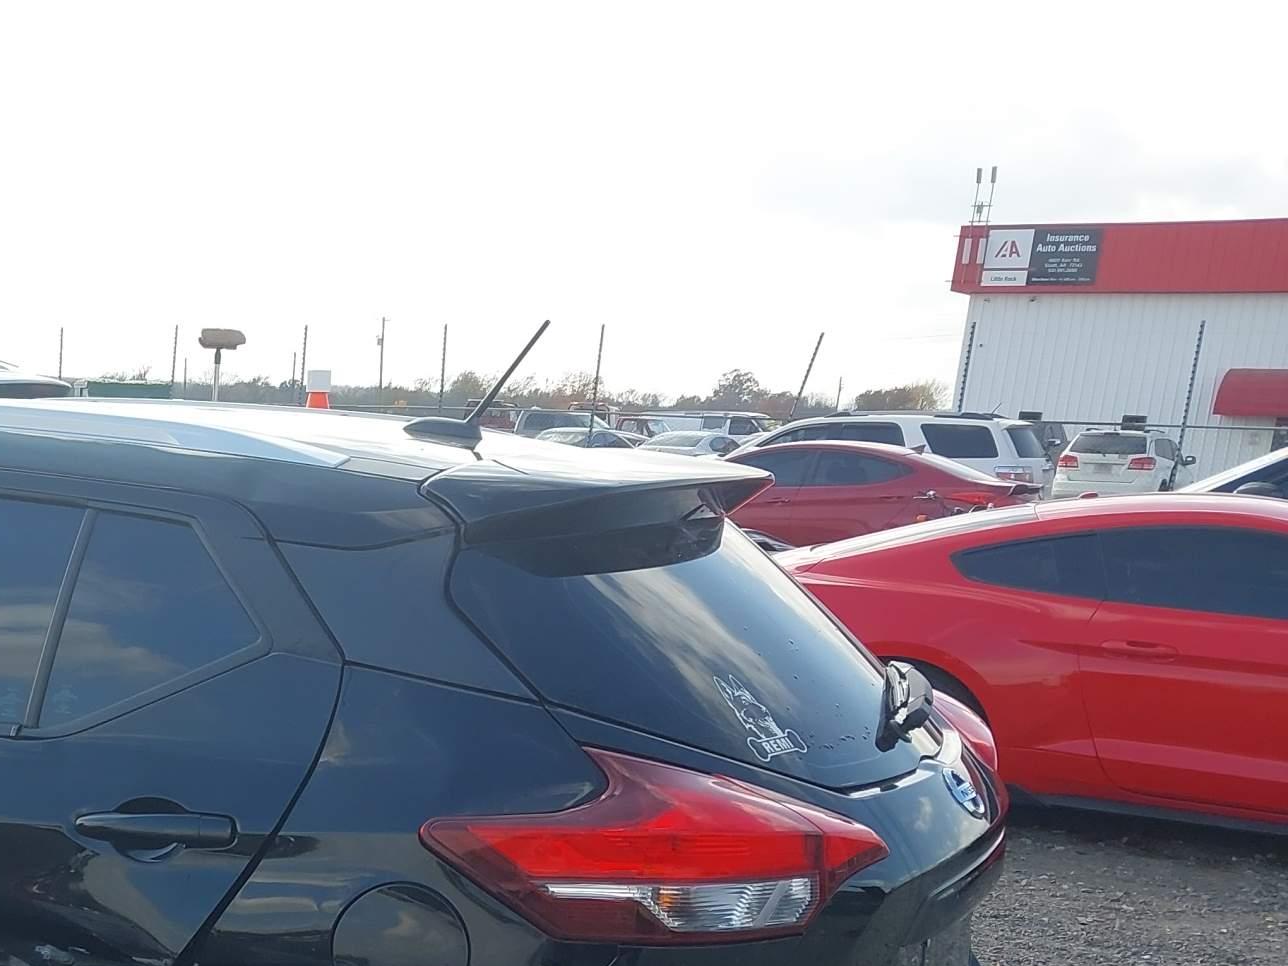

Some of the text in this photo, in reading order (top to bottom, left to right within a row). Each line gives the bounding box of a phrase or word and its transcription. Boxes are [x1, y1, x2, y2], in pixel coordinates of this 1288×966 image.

[1046, 233, 1090, 242] Insurance
[1036, 243, 1097, 252] Auto Auctions
[762, 736, 794, 754] REMI
